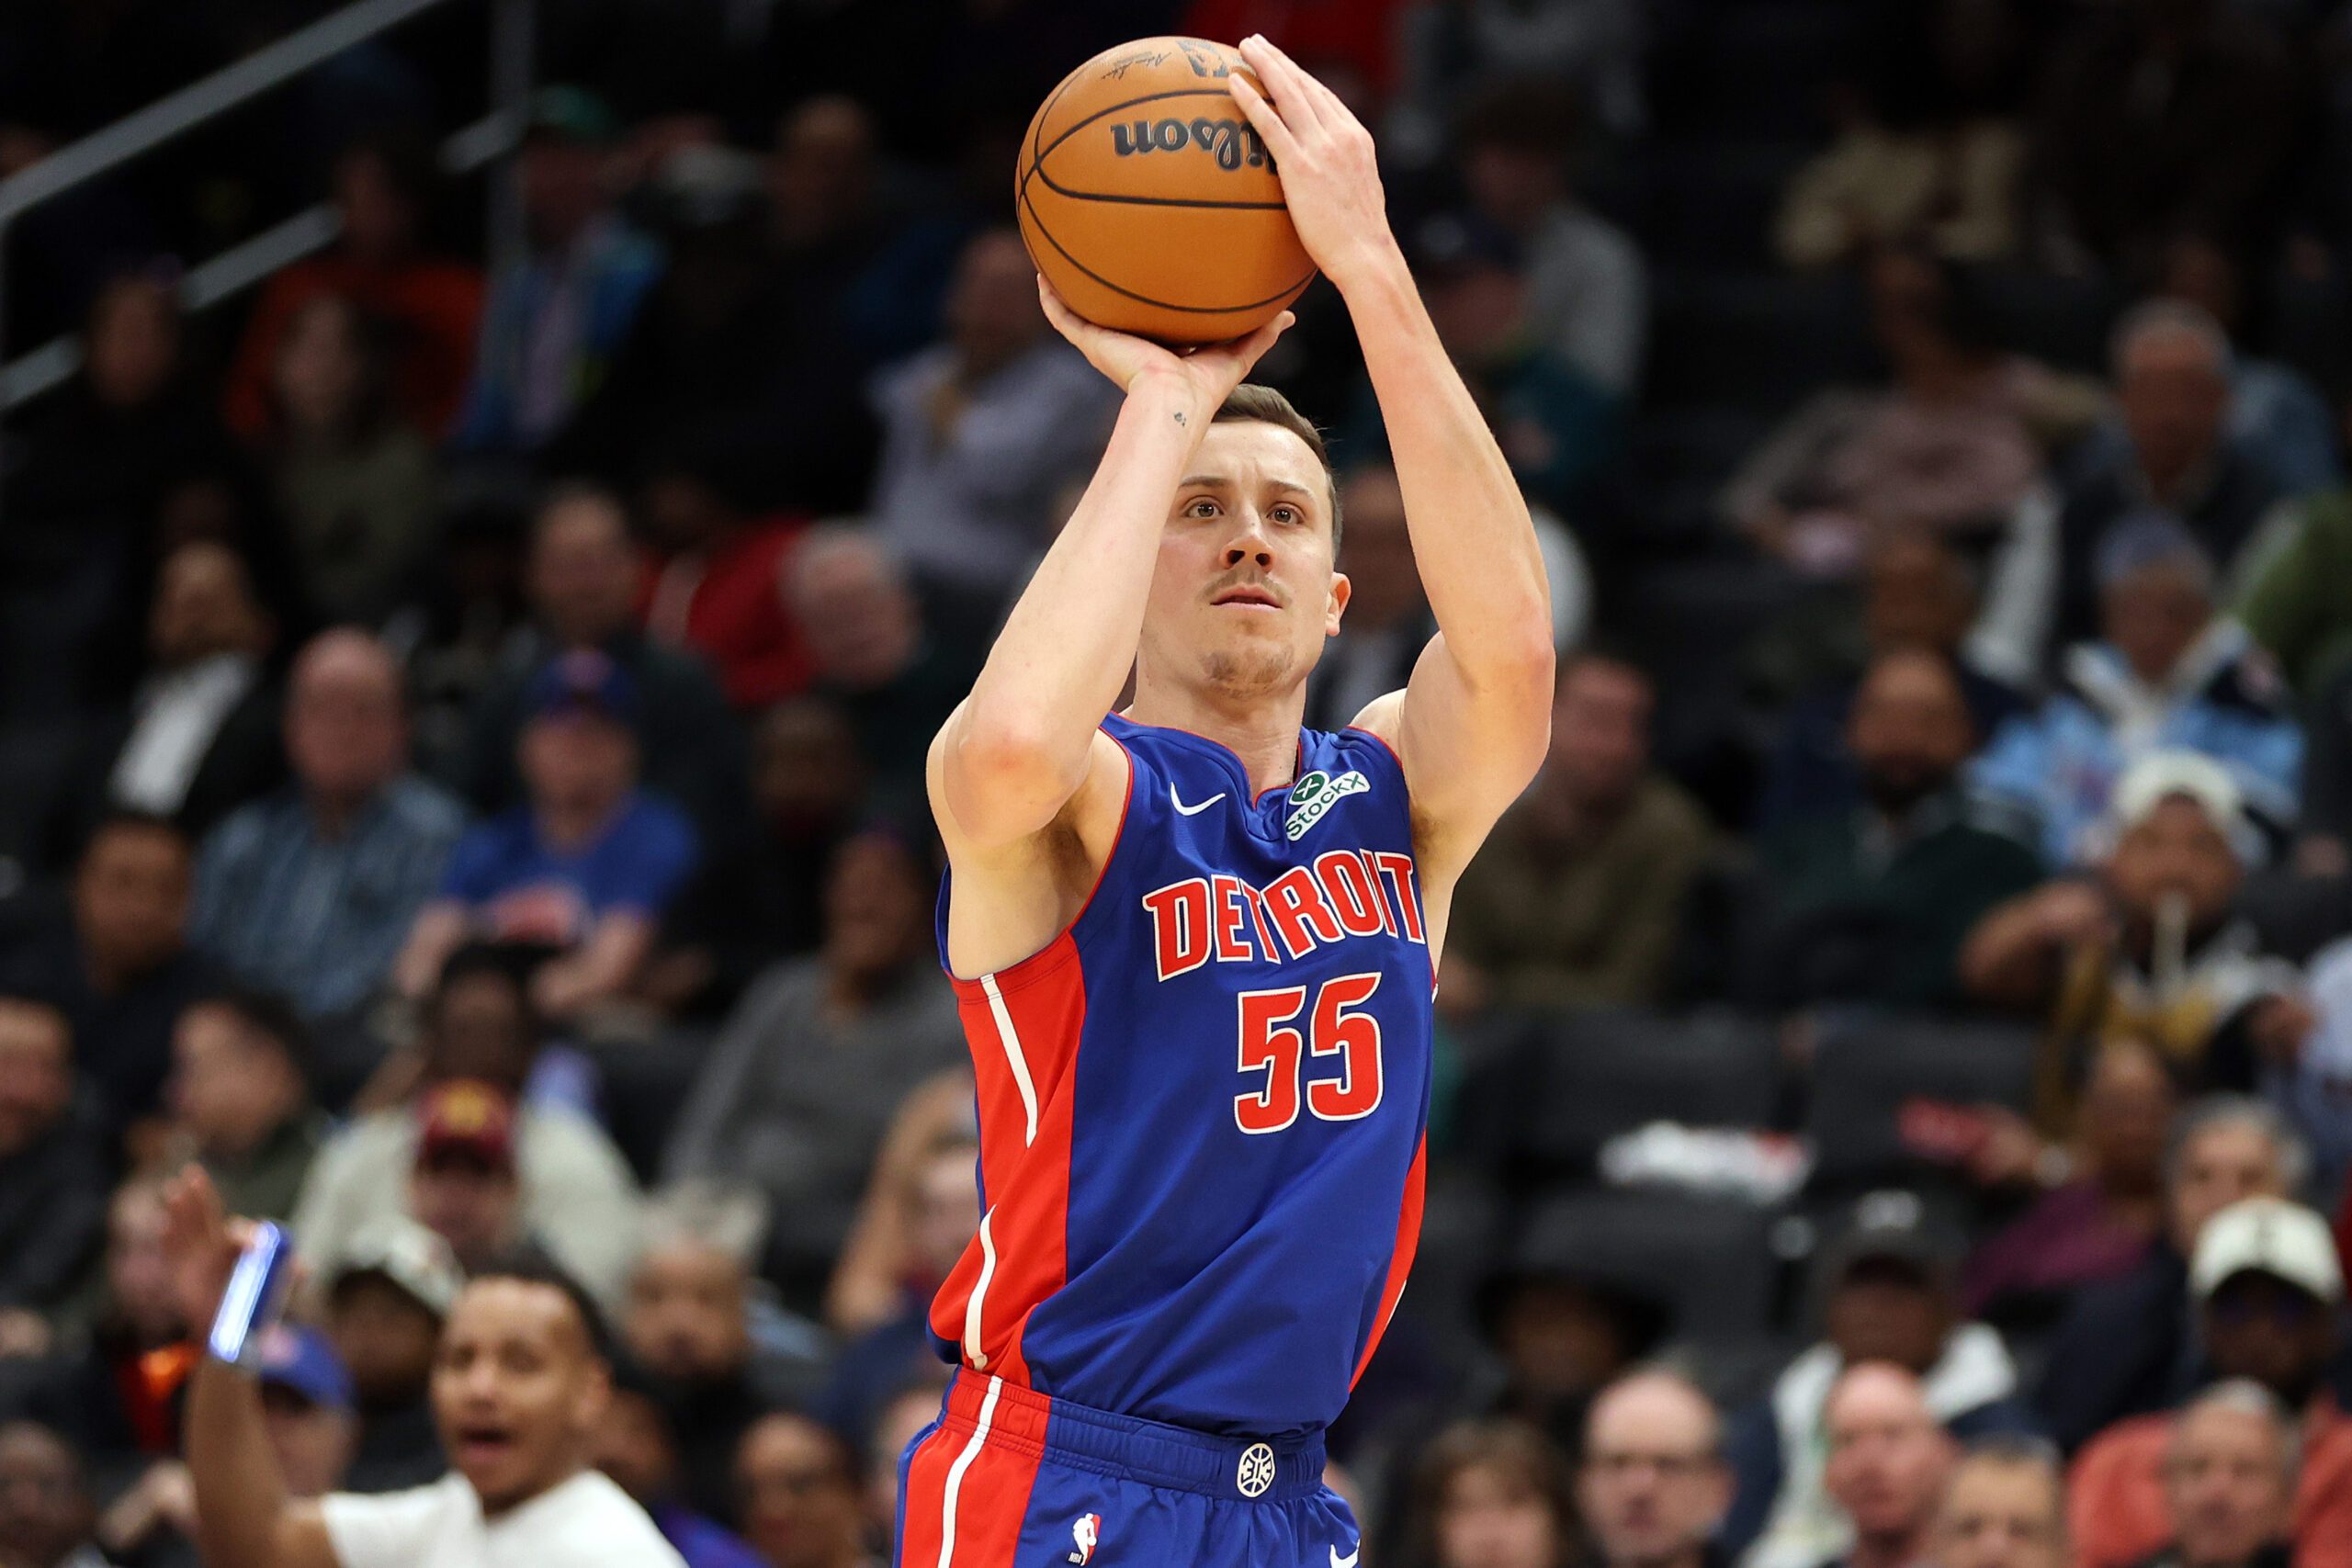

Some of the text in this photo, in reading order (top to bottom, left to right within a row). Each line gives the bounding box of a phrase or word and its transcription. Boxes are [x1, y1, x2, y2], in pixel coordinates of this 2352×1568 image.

[1110, 117, 1279, 175] ilson
[1286, 773, 1366, 837] StockX
[1142, 848, 1425, 982] DETROIT
[1235, 972, 1384, 1134] 55
